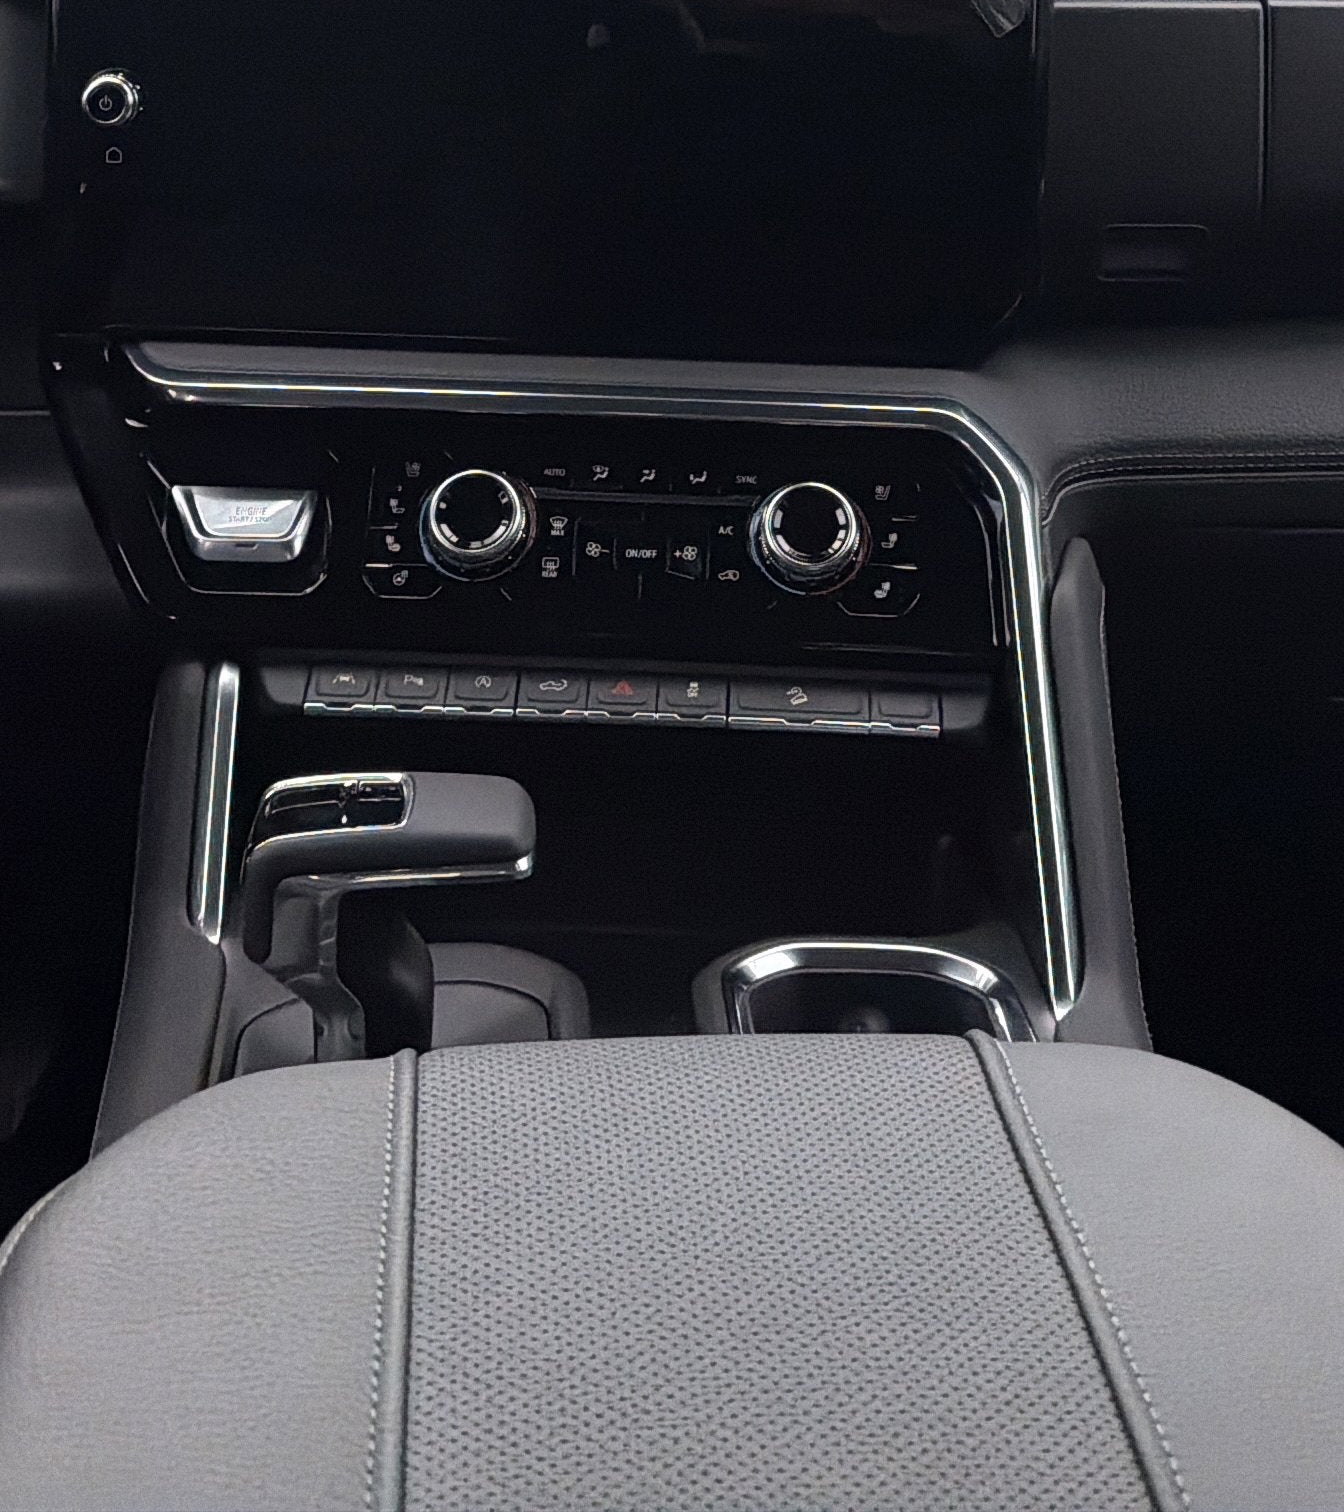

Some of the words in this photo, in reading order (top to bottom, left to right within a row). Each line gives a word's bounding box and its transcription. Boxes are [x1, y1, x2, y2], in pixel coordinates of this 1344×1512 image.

[543, 468, 566, 476] AUTO
[735, 475, 757, 484] SYNC
[718, 526, 734, 535] A/C
[625, 548, 658, 558] ON/OFF
